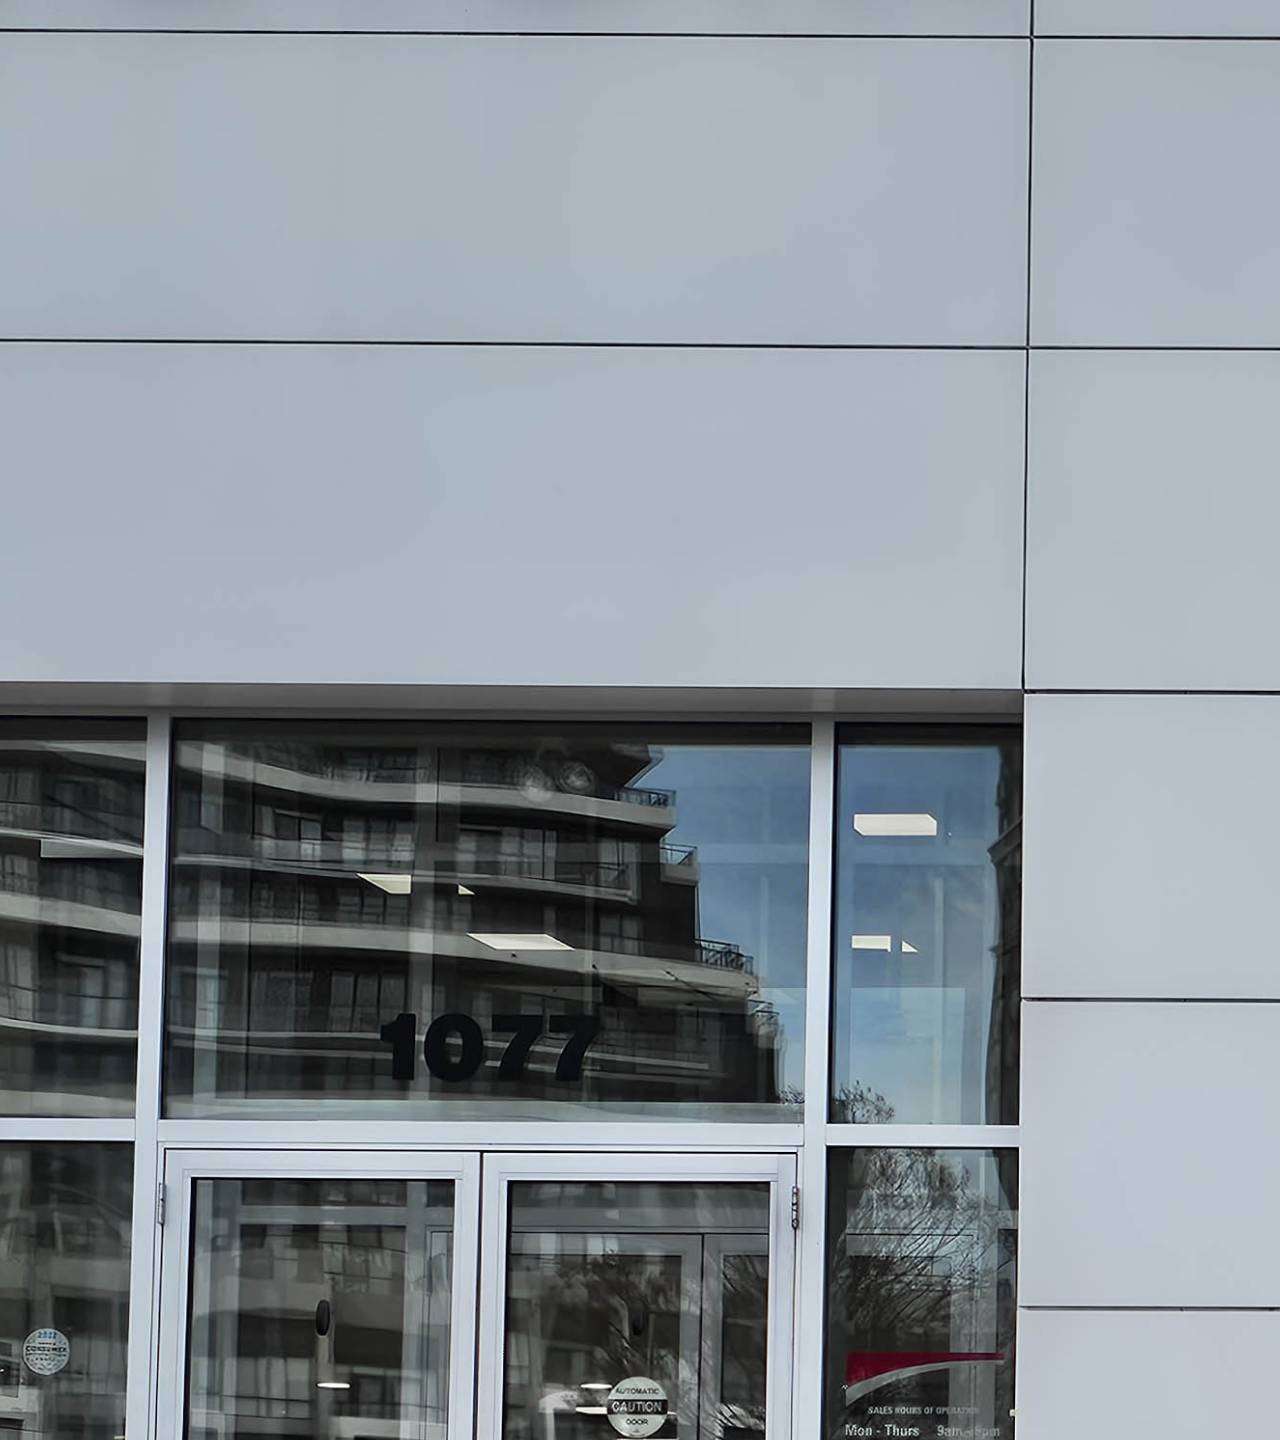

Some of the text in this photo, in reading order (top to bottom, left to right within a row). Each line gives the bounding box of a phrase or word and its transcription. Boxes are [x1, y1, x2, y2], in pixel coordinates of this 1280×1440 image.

[380, 1013, 600, 1082] 1077
[615, 1387, 660, 1395] AUTOMATIC
[611, 1400, 663, 1413] CAUTION
[625, 1418, 649, 1426] DOOR
[845, 1424, 873, 1437] Mon
[884, 1424, 920, 1437] Thurs
